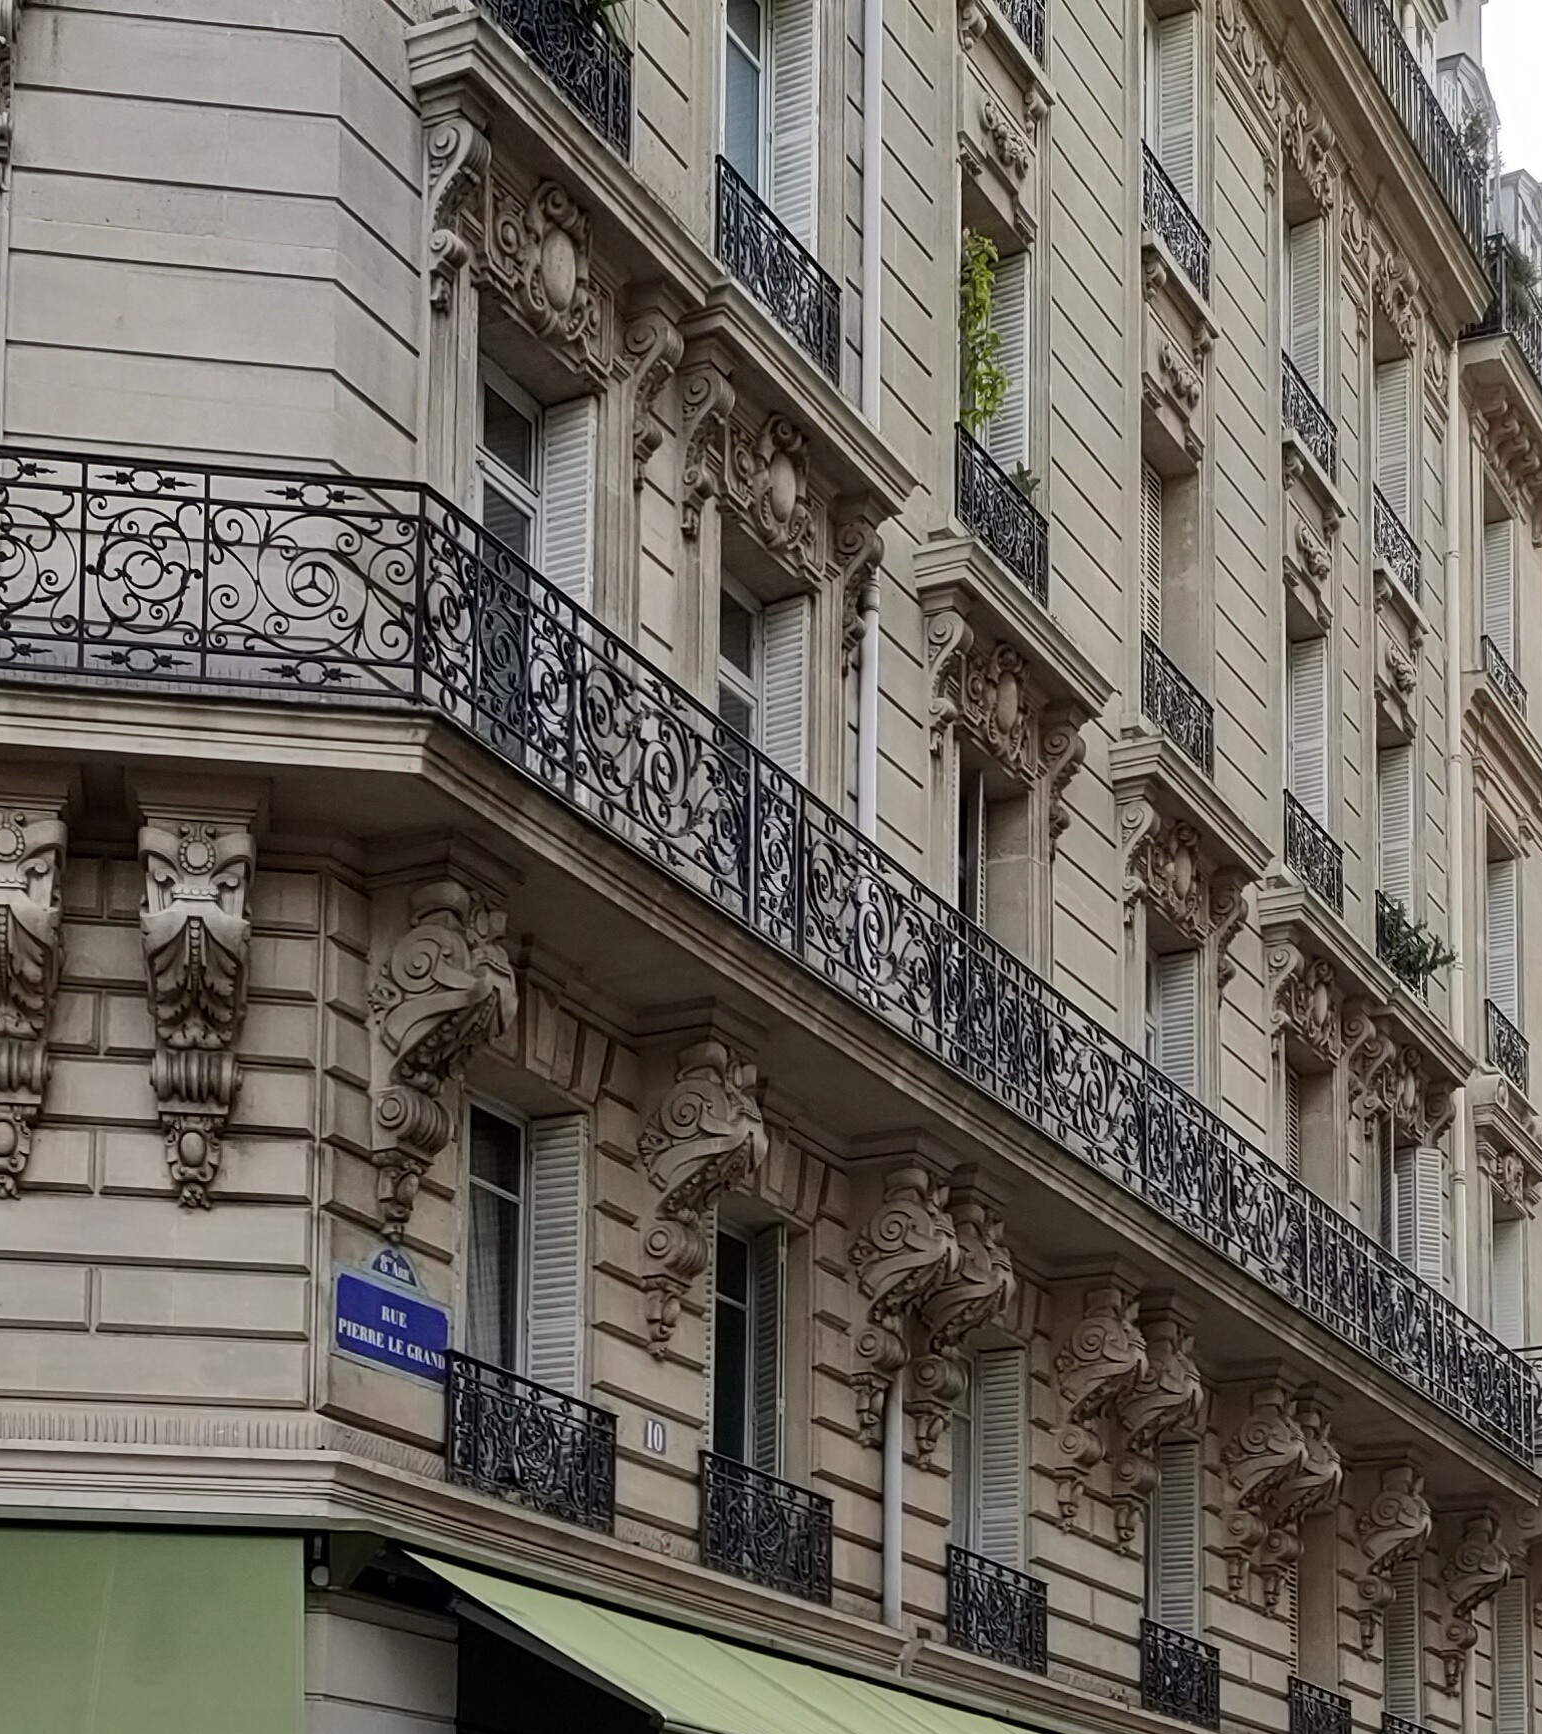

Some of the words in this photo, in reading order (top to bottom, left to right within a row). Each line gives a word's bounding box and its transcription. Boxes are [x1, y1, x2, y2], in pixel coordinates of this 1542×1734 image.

[381, 1305, 407, 1328] RUE
[338, 1317, 384, 1348] PIERRE
[388, 1335, 404, 1355] LE
[407, 1343, 445, 1370] GRAND
[647, 1420, 663, 1451] 10
